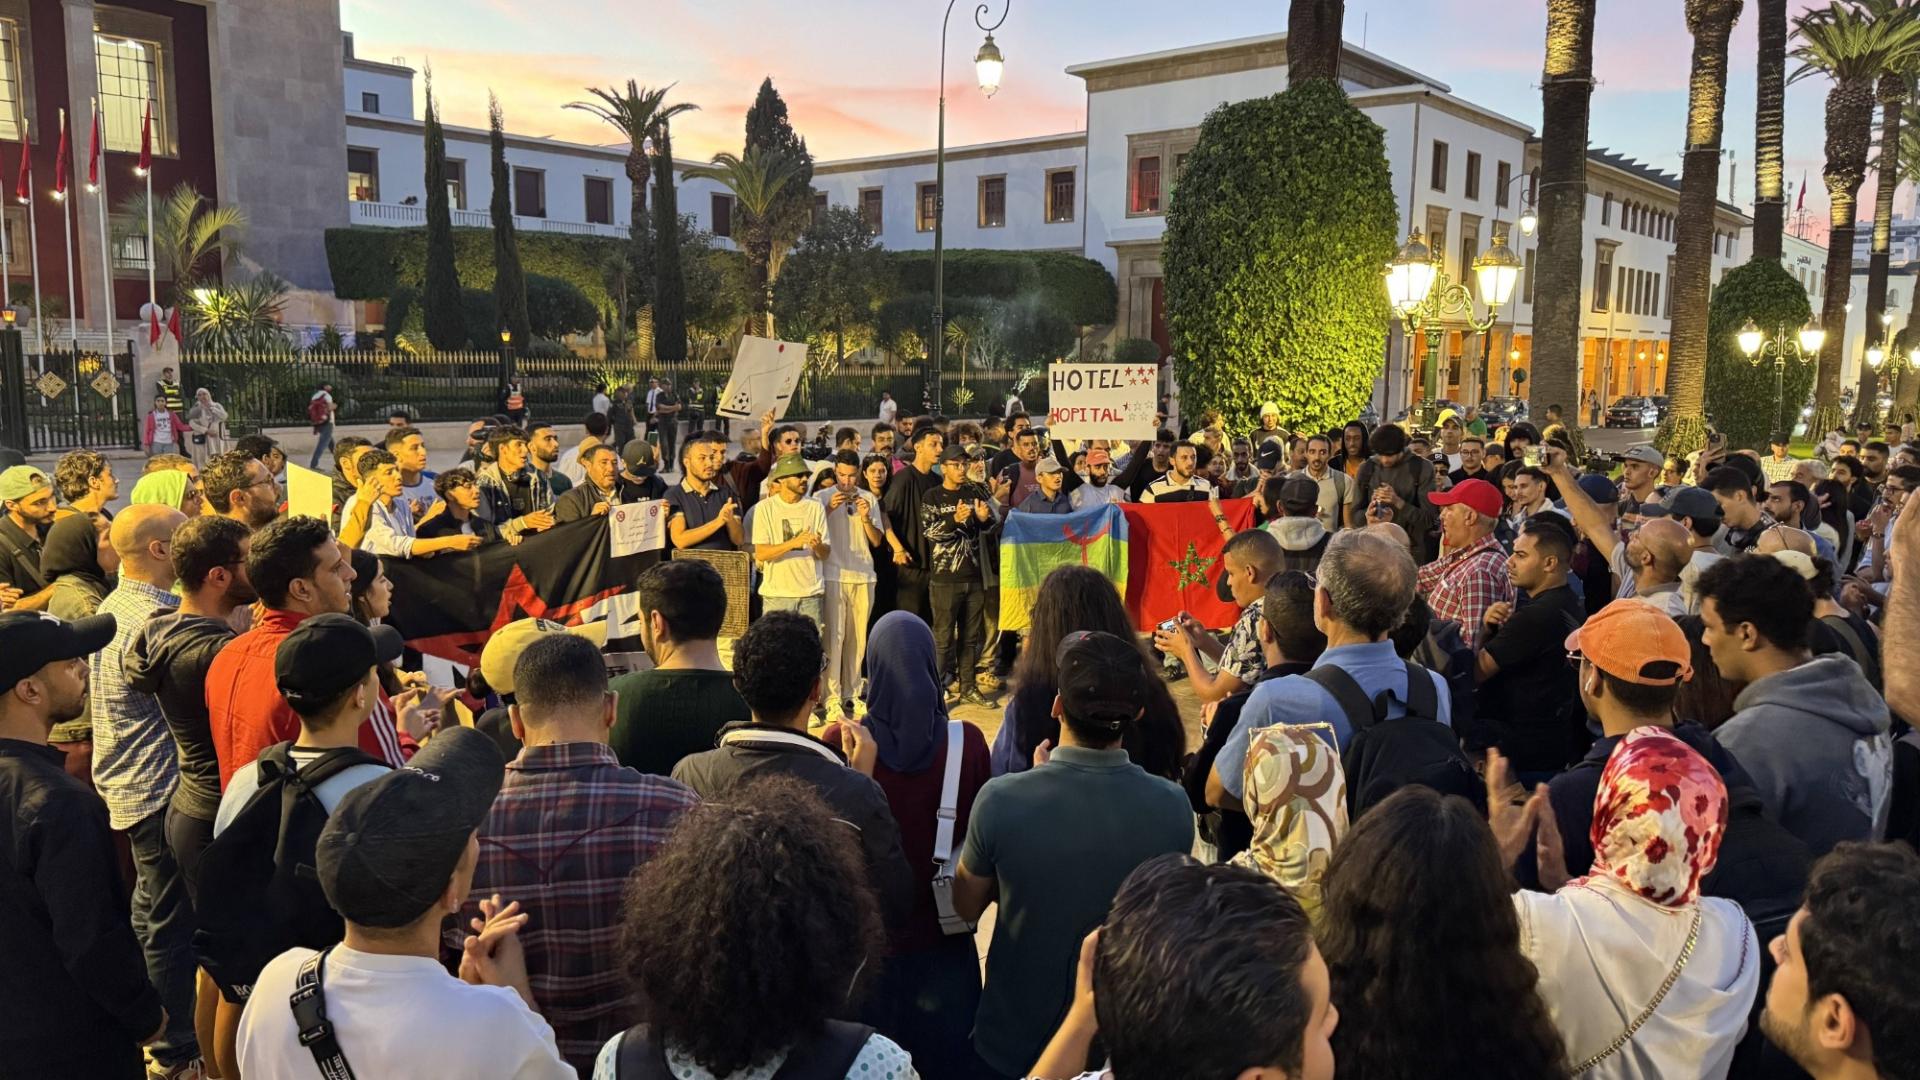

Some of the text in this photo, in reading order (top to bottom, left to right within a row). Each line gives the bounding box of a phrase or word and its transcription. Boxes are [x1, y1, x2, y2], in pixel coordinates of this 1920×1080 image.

[1052, 369, 1124, 391] HOTEL
[1050, 407, 1124, 423] HOPITAL
[231, 984, 253, 994] BO
